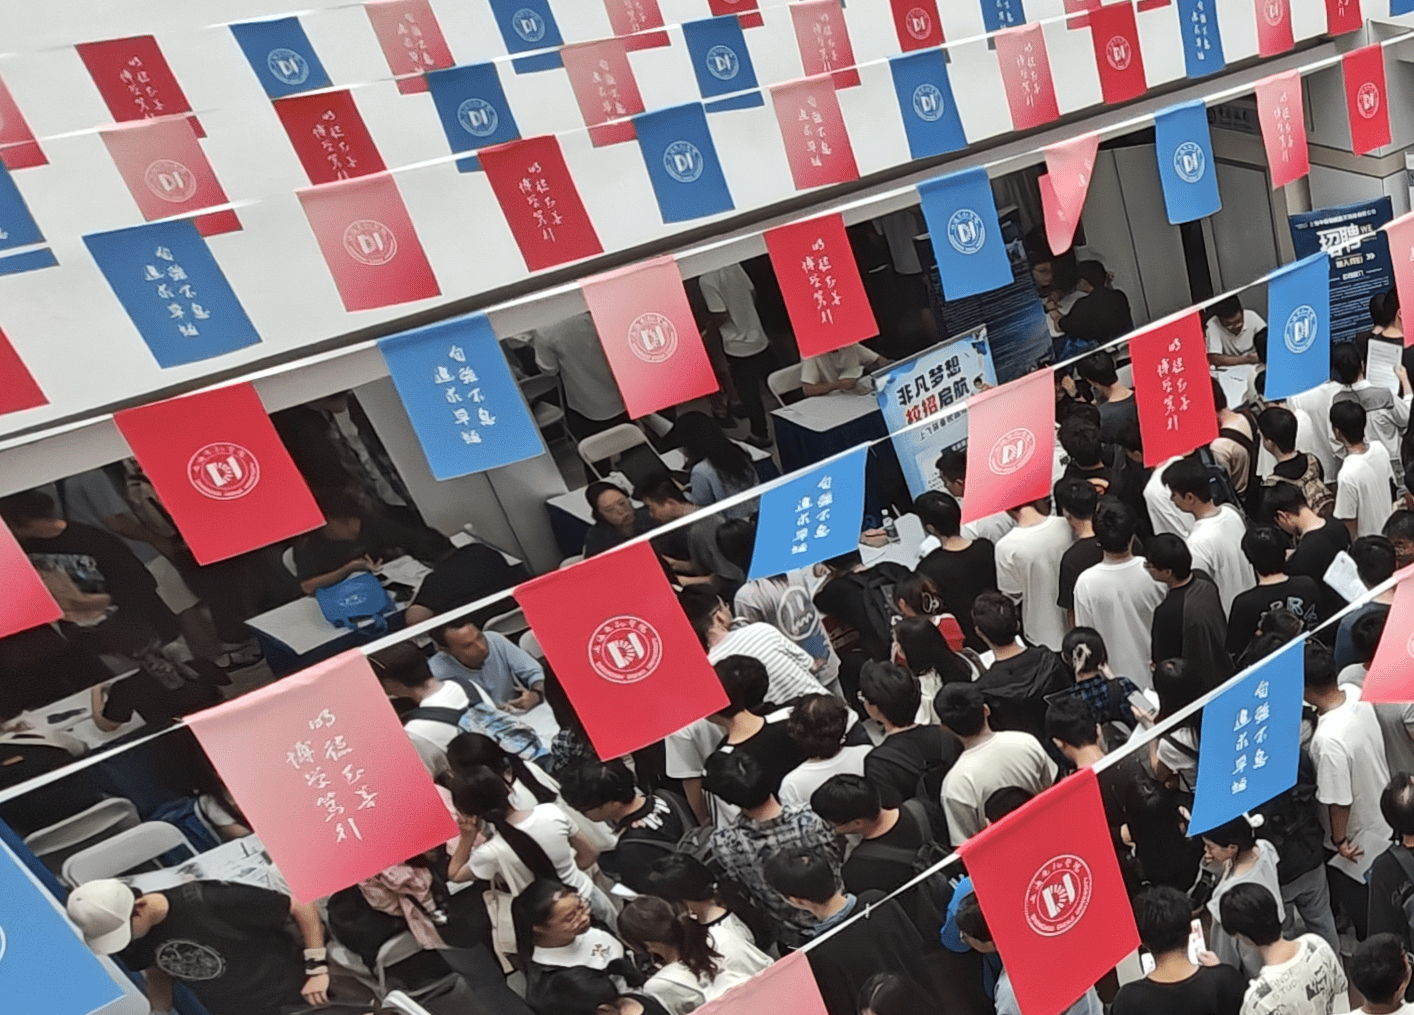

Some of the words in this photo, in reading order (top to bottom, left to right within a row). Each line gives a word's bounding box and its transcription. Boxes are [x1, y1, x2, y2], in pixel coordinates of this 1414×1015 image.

[896, 355, 962, 406] 非凡梦想
[905, 376, 971, 425] 校招启航
[308, 708, 379, 811] 明德至善
[1231, 708, 1253, 795] 追求卓越
[1253, 679, 1271, 770] 自强不息
[285, 740, 364, 843] 博学笃行
